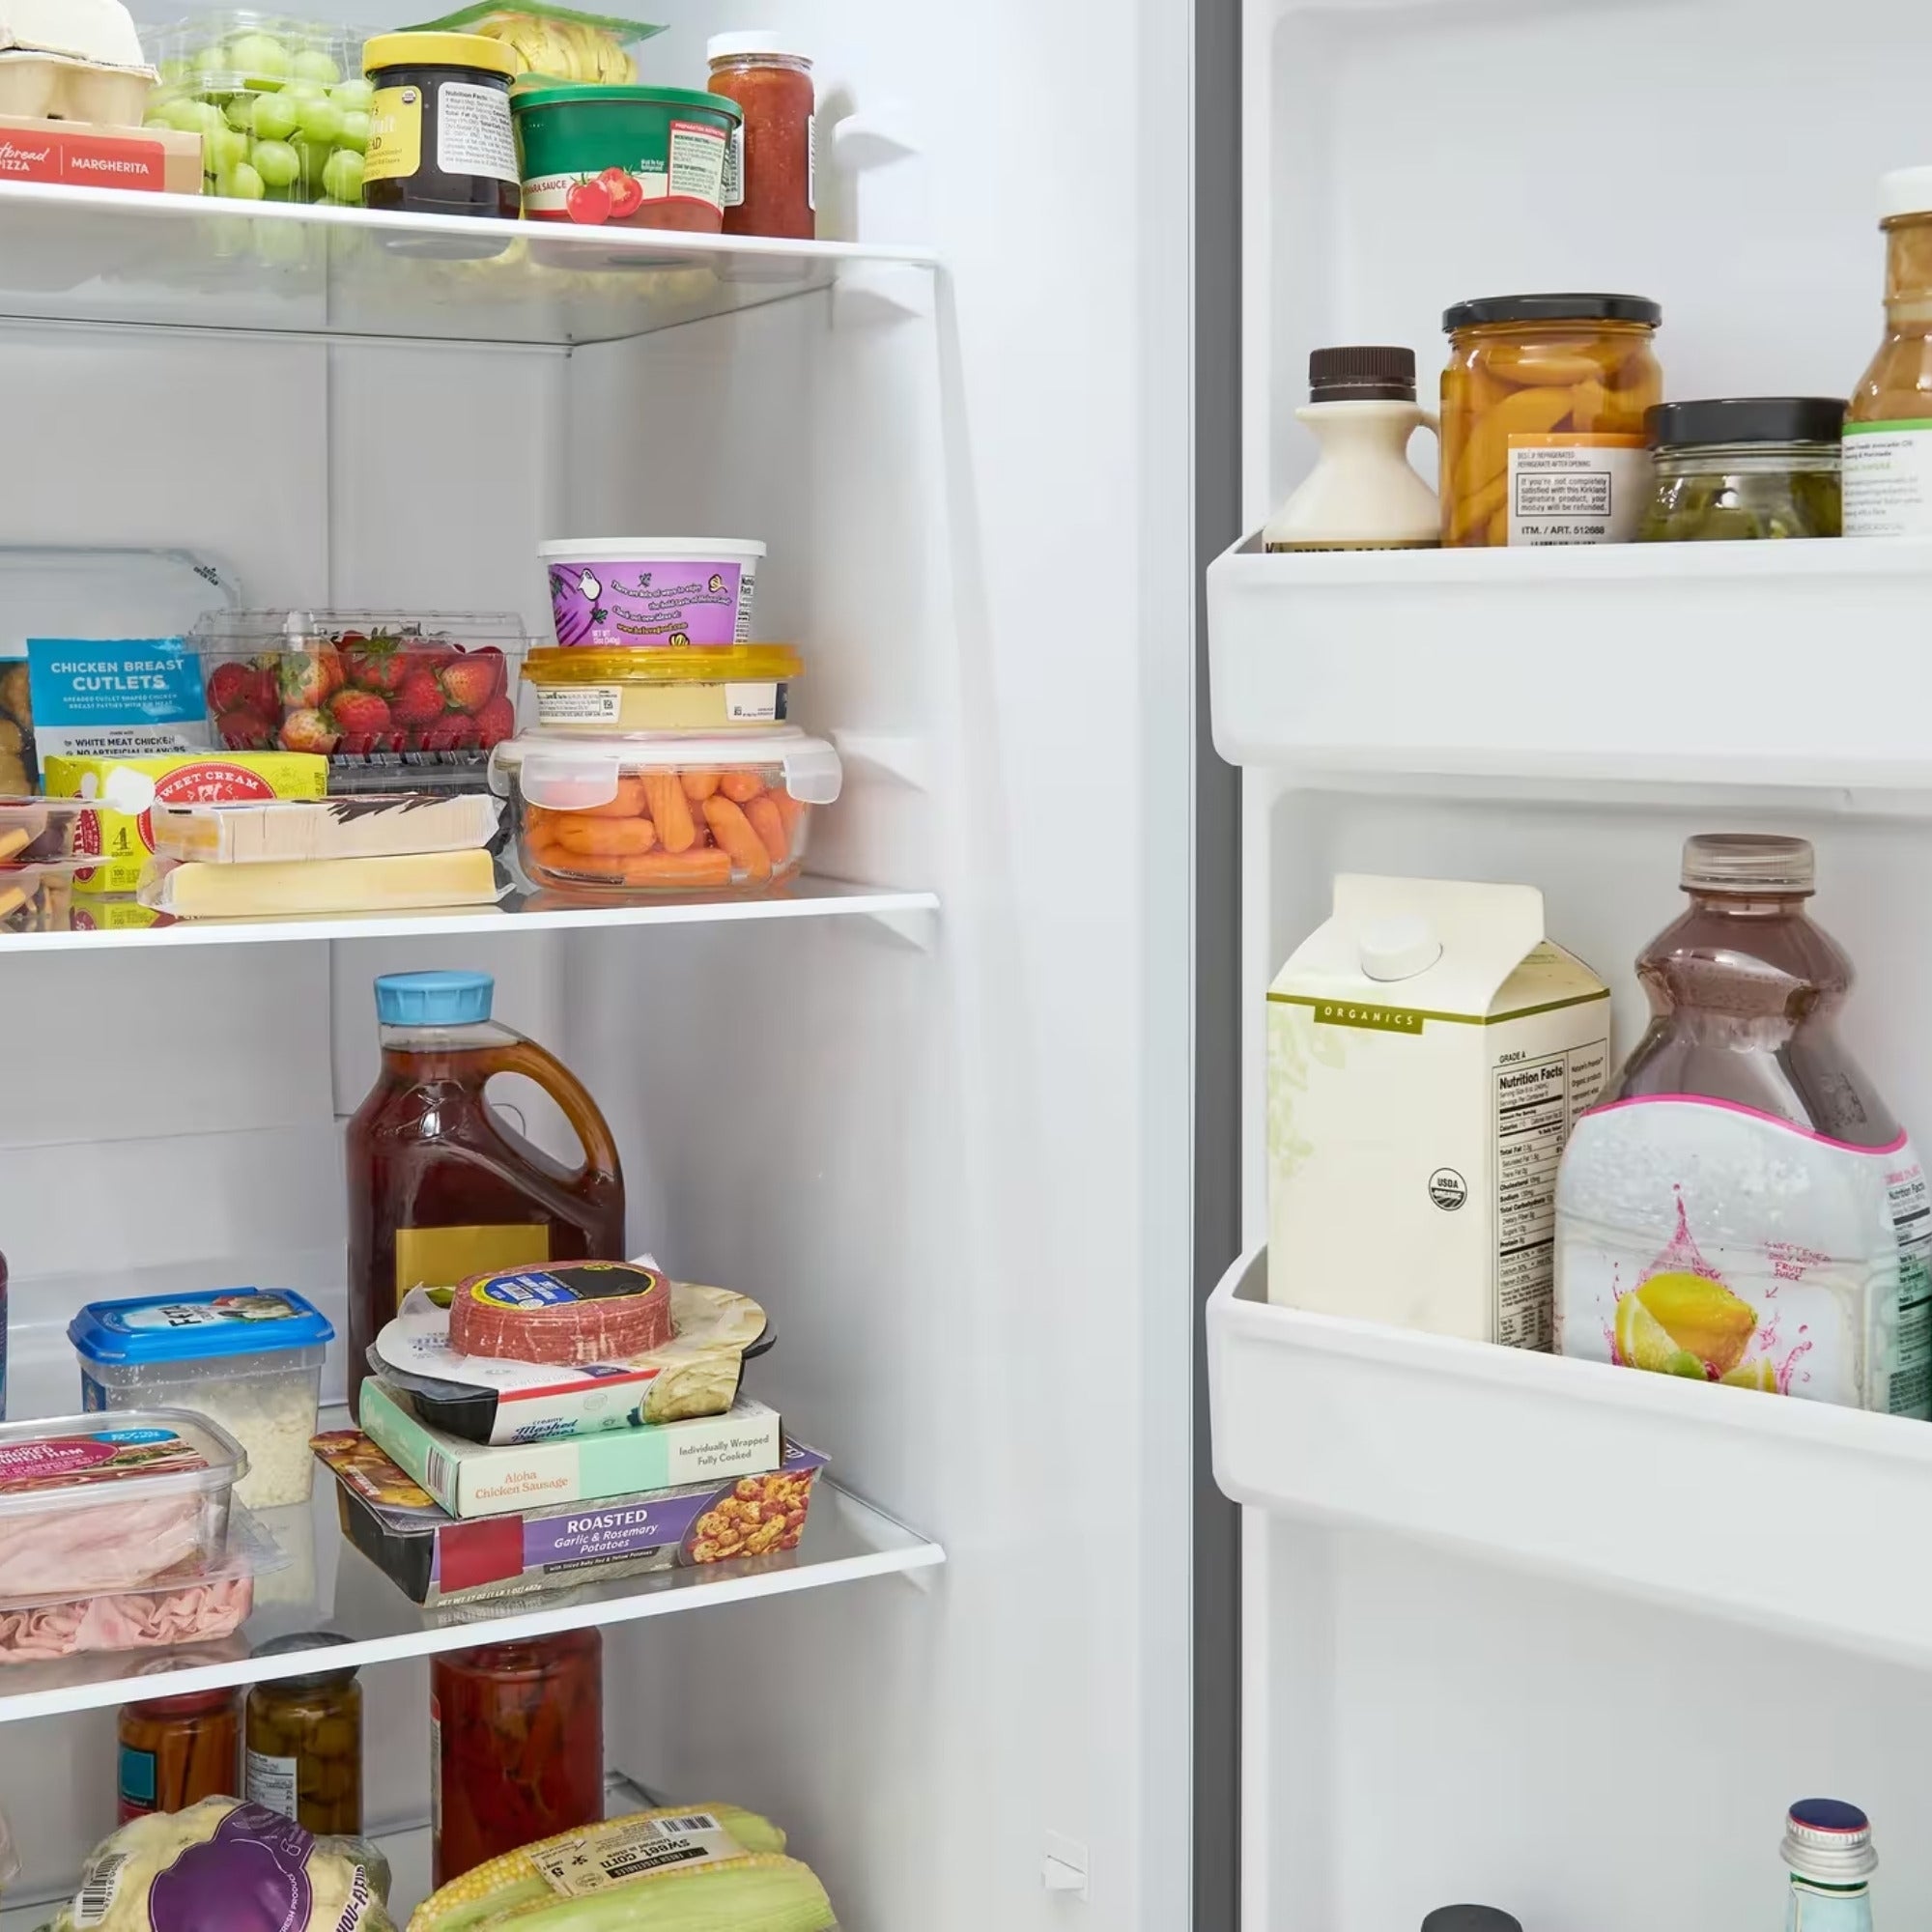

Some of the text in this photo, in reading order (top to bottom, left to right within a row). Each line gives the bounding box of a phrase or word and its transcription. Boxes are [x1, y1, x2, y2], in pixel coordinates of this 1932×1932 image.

[0, 158, 30, 172] IZZA
[71, 156, 149, 175] MARGHERITA
[543, 180, 567, 192] SAUCE
[1549, 526, 1572, 534] ART.
[51, 660, 184, 673] CHICKEN BREAST
[72, 674, 166, 691] CUTLETS
[75, 736, 175, 748] WHITE MEAT CHICKEN
[155, 771, 258, 806] SWEET CREAM
[113, 827, 131, 850] 4
[1324, 1007, 1413, 1025] ORGANICS
[1499, 1052, 1520, 1064] GRADE
[1499, 1065, 1563, 1090] Nutrition Facts
[1499, 1090, 1515, 1098] Serving
[1499, 1123, 1518, 1132] Calories
[1437, 1178, 1459, 1189] USDA
[1499, 1179, 1528, 1191] Cholesterol
[1499, 1193, 1520, 1203] Sodium
[1514, 1197, 1546, 1210] Carbohydrate
[1499, 1239, 1518, 1248] Protein
[1773, 1268, 1803, 1282] JUICE
[1775, 1262, 1807, 1274] FRUIT
[515, 1418, 579, 1435] Mashed
[531, 1416, 564, 1426] creamy
[511, 1428, 575, 1443] Potatoes
[0, 1444, 54, 1461] MOKED
[679, 1435, 770, 1456] Individually Wrapped
[697, 1449, 752, 1466] Fully Cooked
[505, 1470, 537, 1484] Aloha
[475, 1476, 569, 1499] Chicken Sausage
[566, 1509, 648, 1534] ROASTED
[554, 1523, 659, 1548] Garlic & Rosemary
[580, 1538, 630, 1554] Potatoes
[581, 1559, 593, 1568] Baby
[630, 1549, 653, 1559] Potatoes
[600, 1837, 692, 1869] sweet corn
[614, 1856, 662, 1877] VEGETABLES
